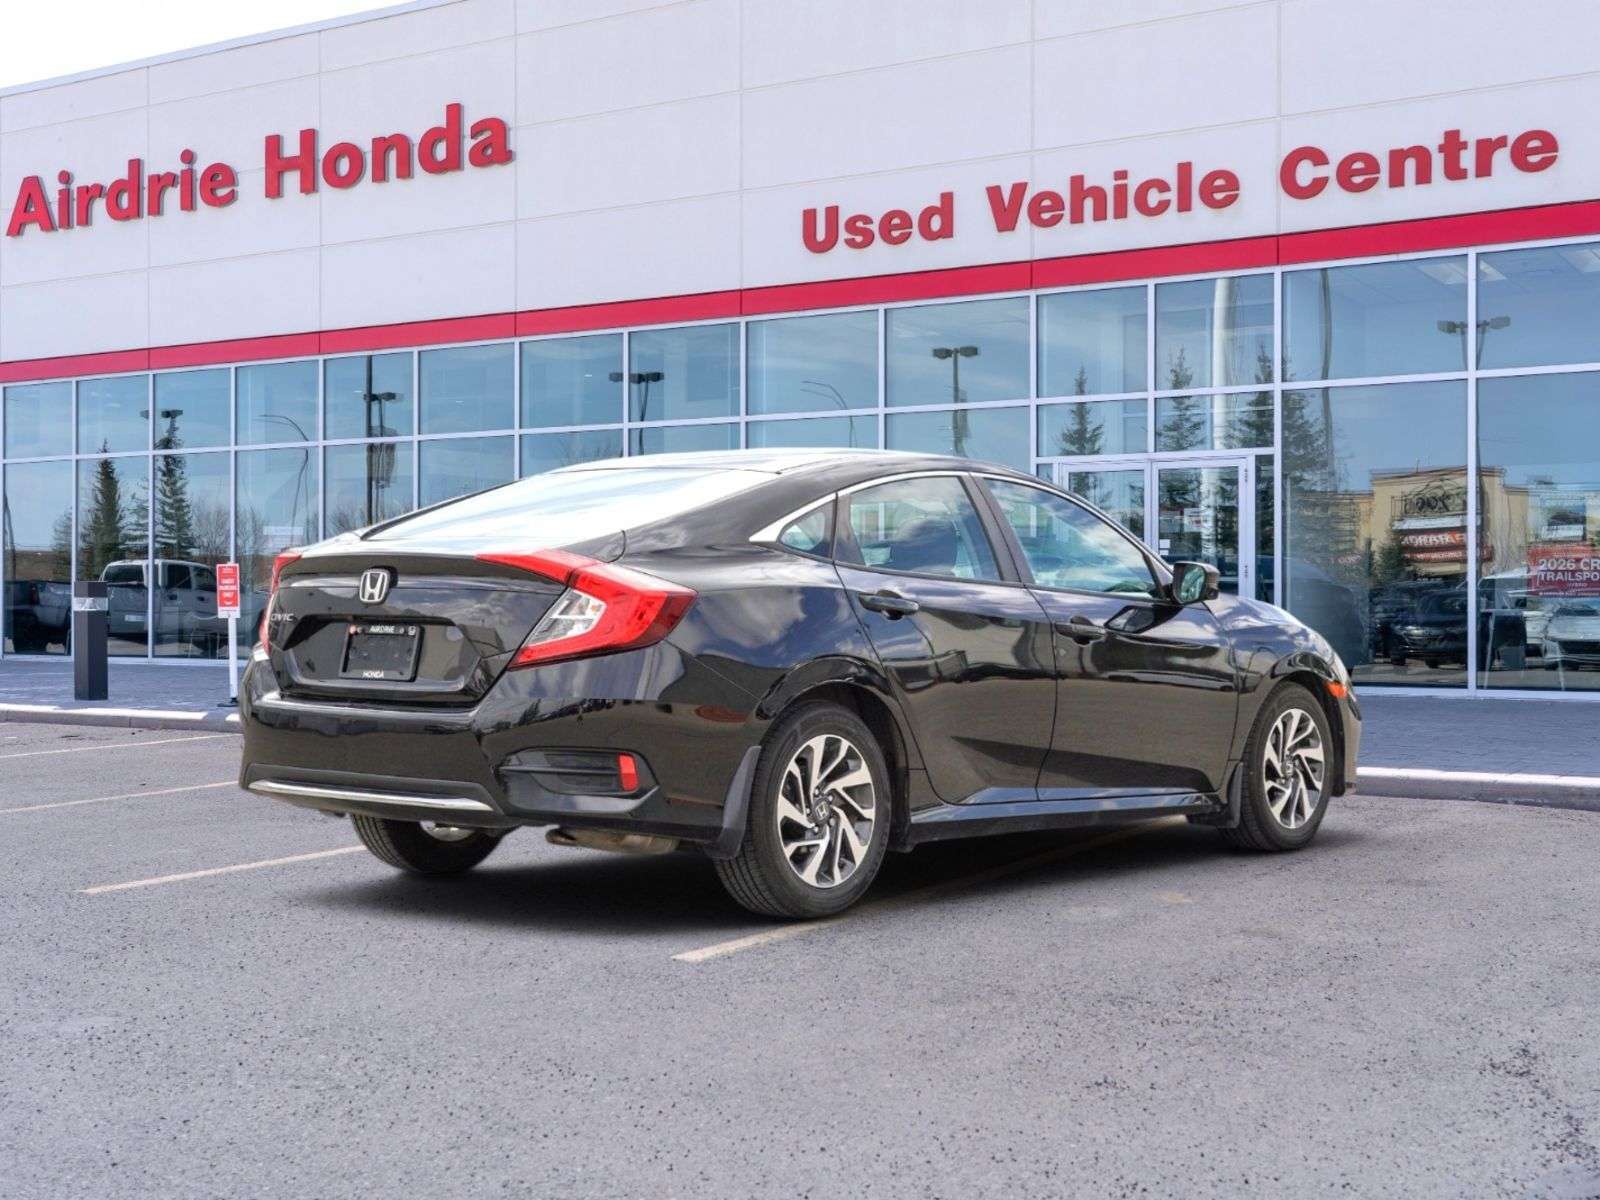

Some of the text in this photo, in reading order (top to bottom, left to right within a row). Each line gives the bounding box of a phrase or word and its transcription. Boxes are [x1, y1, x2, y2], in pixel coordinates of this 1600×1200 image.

[7, 103, 513, 236] Airdrie Honda
[802, 130, 1559, 253] Used Vehicle Centre
[1538, 558, 1576, 570] 2026
[361, 671, 385, 679] HONDA
